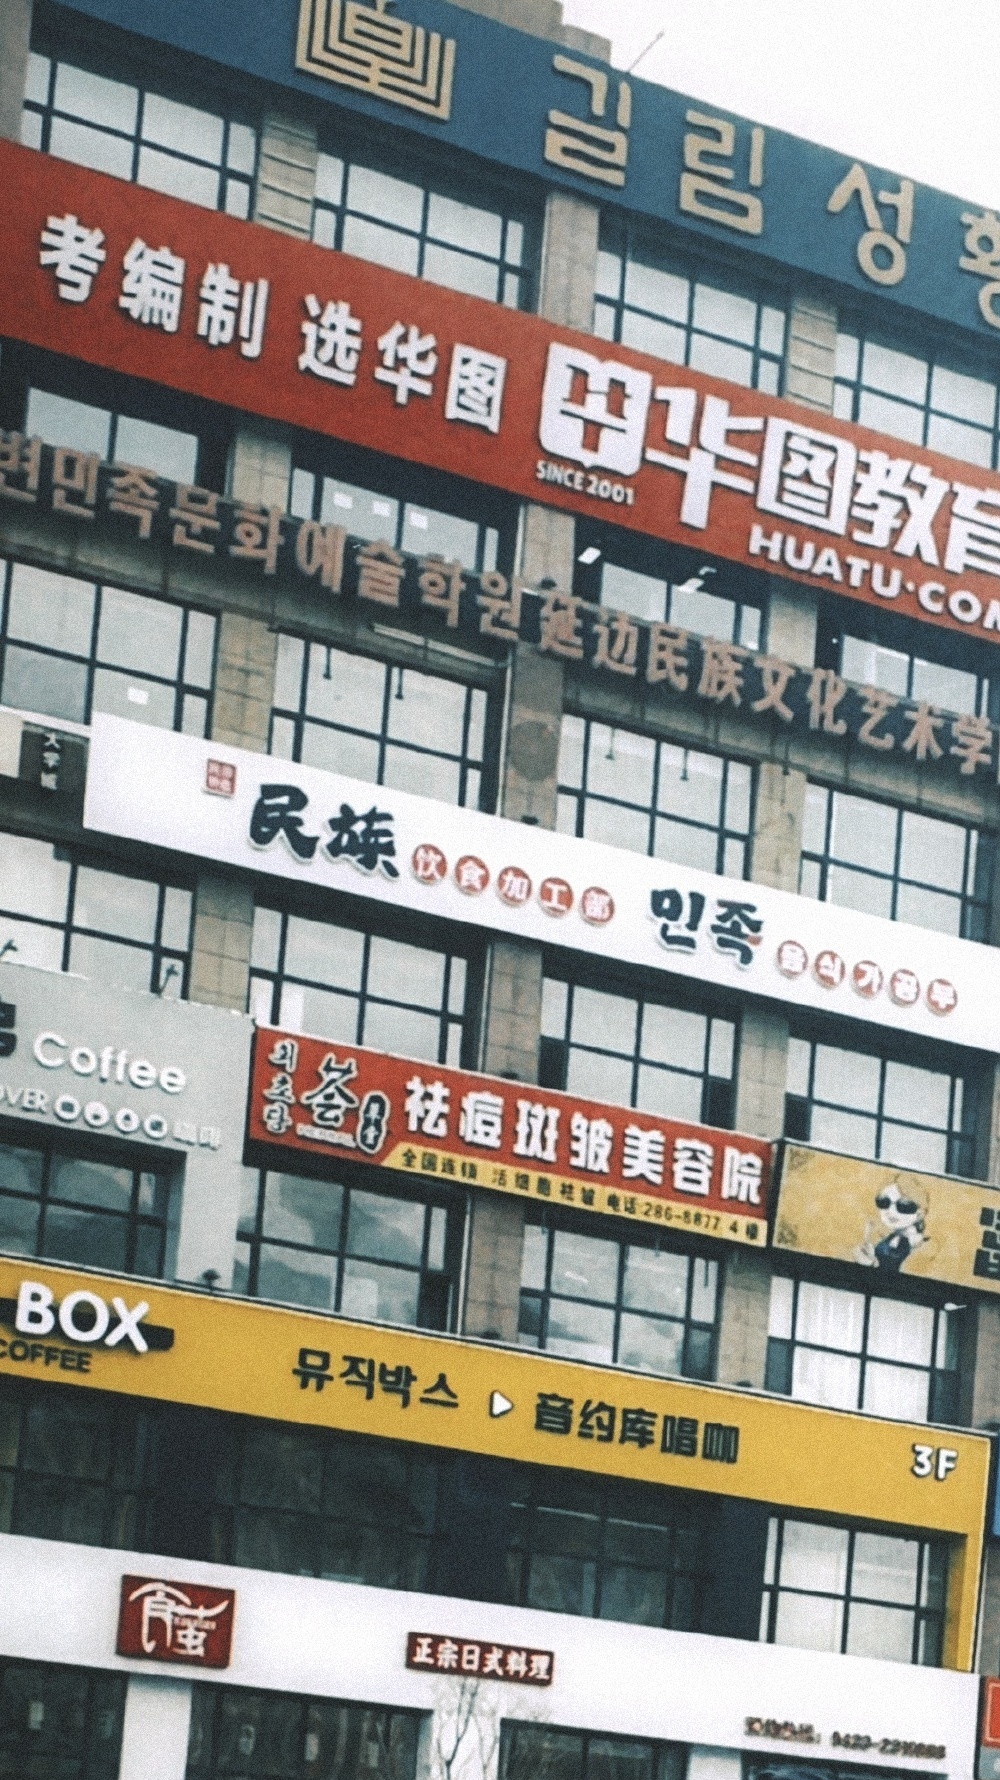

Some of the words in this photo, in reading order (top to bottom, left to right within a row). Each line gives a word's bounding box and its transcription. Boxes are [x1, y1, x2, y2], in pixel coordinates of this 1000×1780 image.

[39, 213, 269, 359] 考编制
[298, 294, 507, 434] 选华图
[536, 458, 586, 492] SINCE
[587, 473, 634, 505] 2001
[249, 784, 399, 878] 民族
[412, 844, 614, 925] 饮食加工部
[650, 888, 764, 967] 민족
[34, 1031, 187, 1093] Coffee
[405, 1076, 764, 1204] 祛痘斑皱美容院
[16, 1281, 148, 1353] BOX
[291, 1349, 459, 1410] 뮤직박스
[535, 1394, 739, 1464] 音约库唱咖
[912, 1445, 957, 1481] 3F
[412, 1637, 549, 1682] 正宗日式料理
